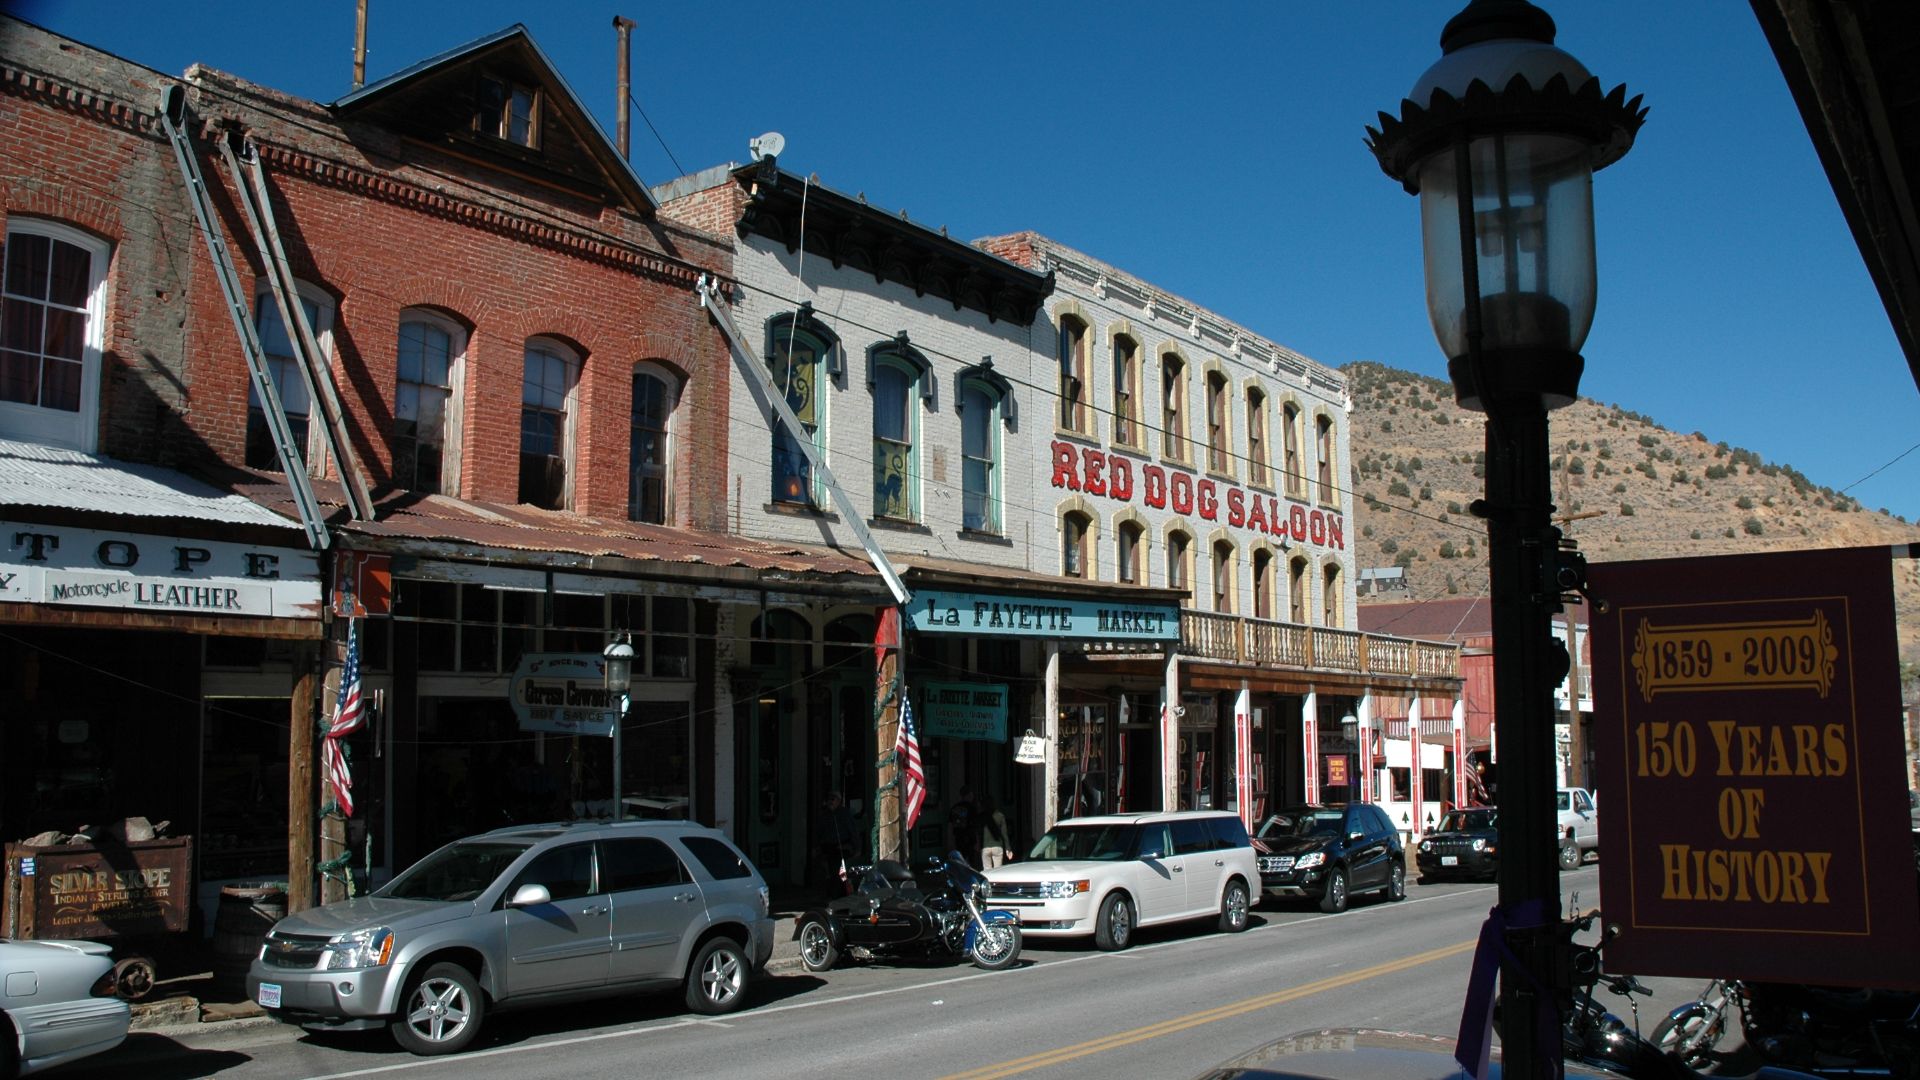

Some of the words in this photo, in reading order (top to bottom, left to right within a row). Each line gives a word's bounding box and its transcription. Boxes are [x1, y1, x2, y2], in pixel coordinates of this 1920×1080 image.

[1051, 440, 1133, 501] RED
[1143, 464, 1219, 522] DOG
[1227, 487, 1345, 550] SALOON
[52, 579, 131, 601] Motorcycle
[134, 583, 242, 610] LEATHER
[927, 597, 960, 627] La
[973, 600, 1073, 632] FAYETTE
[1097, 609, 1166, 634] MARKET
[1652, 639, 1713, 679] 1859
[1743, 635, 1816, 676] 2009
[1635, 721, 1697, 777] 150
[1707, 720, 1848, 777] YEARS
[1718, 787, 1765, 840] OF
[50, 871, 108, 894] SILVER
[115, 867, 171, 890] STOPE
[1659, 844, 1832, 904] HISTORY
[54, 894, 88, 905] INDIAN
[97, 891, 138, 902] STERLING
[143, 888, 169, 898] SILVER
